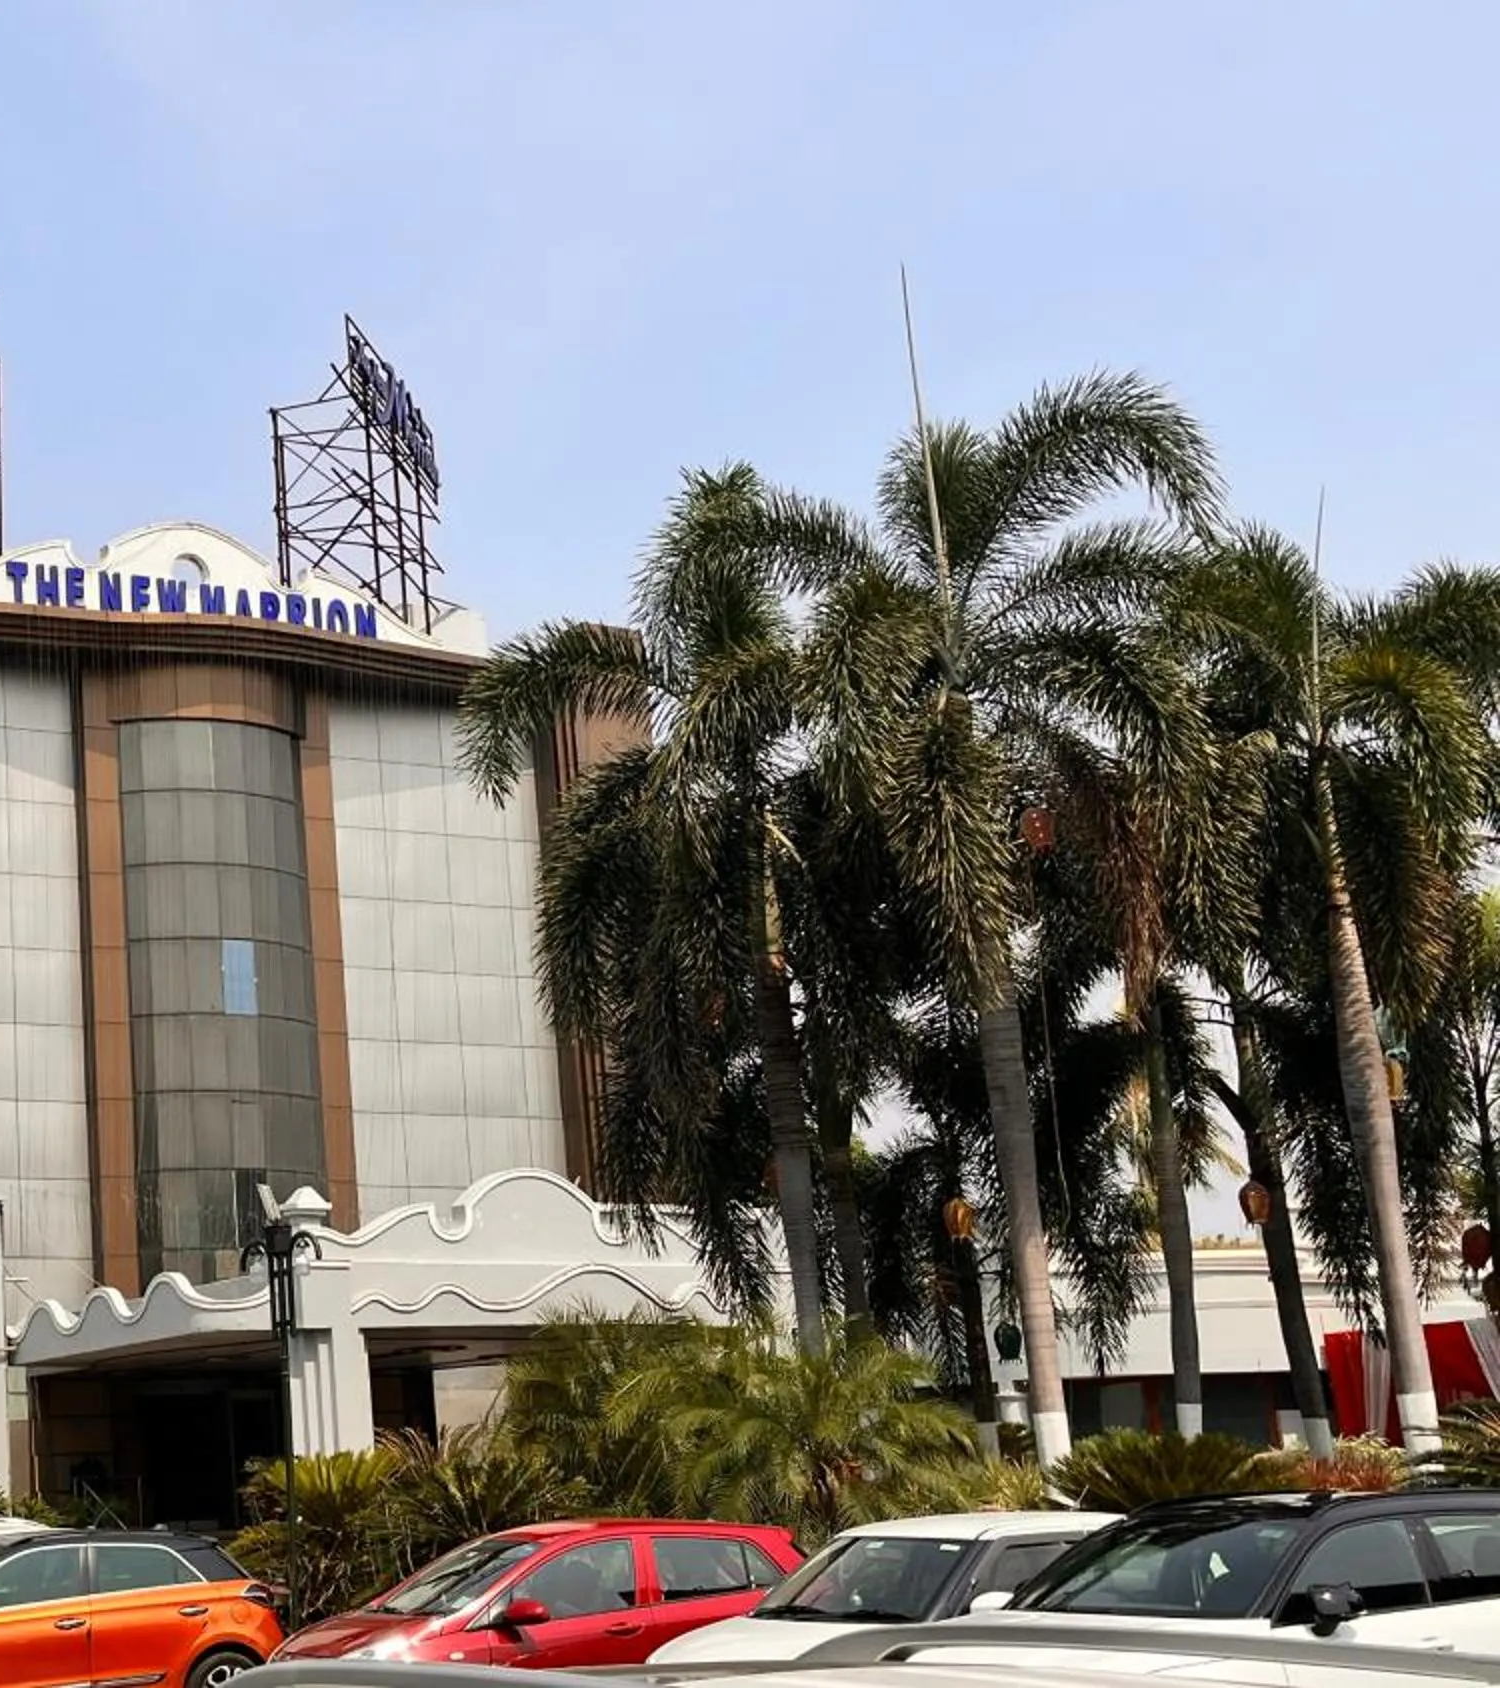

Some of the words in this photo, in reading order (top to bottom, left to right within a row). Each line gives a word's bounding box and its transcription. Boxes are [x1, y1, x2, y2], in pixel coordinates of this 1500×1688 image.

[6, 561, 85, 608] THE
[99, 571, 186, 613] NEW
[200, 584, 378, 640] MARRION
